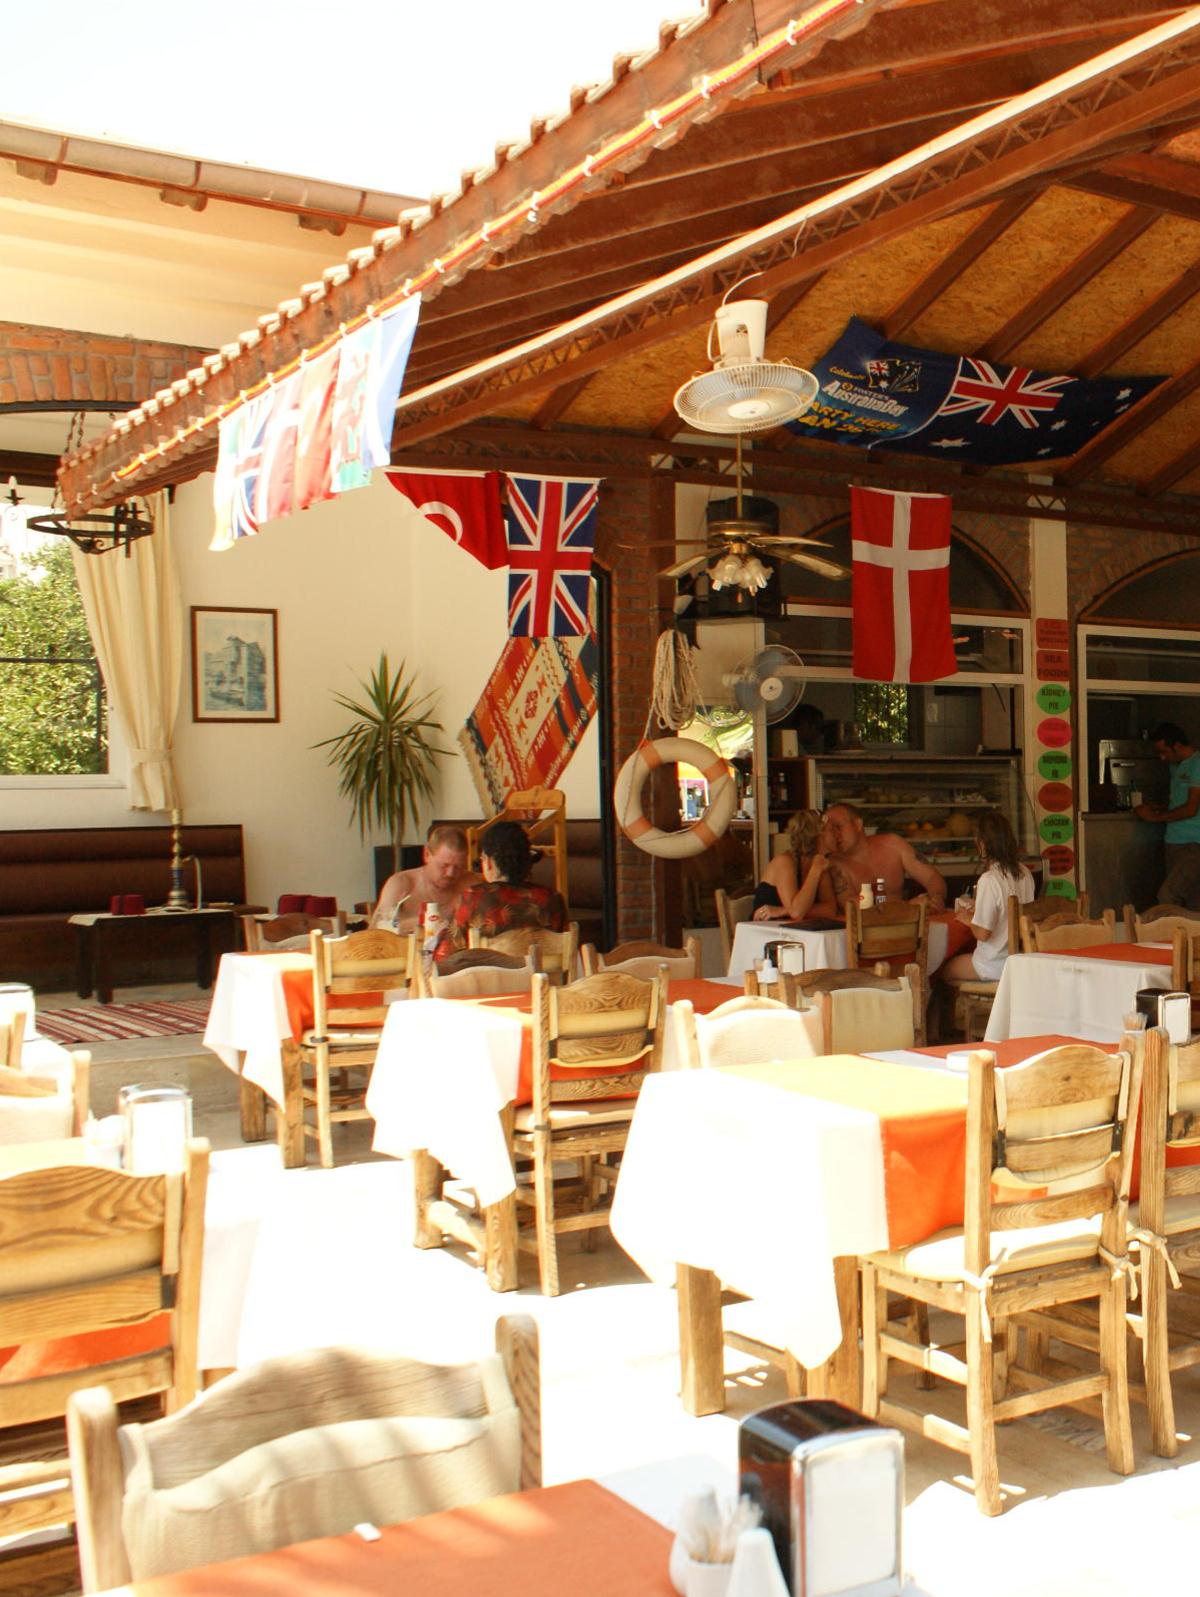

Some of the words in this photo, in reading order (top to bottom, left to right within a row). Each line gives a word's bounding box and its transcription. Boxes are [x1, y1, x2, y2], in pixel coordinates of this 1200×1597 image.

[1038, 667, 1069, 678] FOODS
[1041, 688, 1066, 697] KIDNEY
[1048, 702, 1060, 710] PIE
[1043, 818, 1069, 826] CHICKEN
